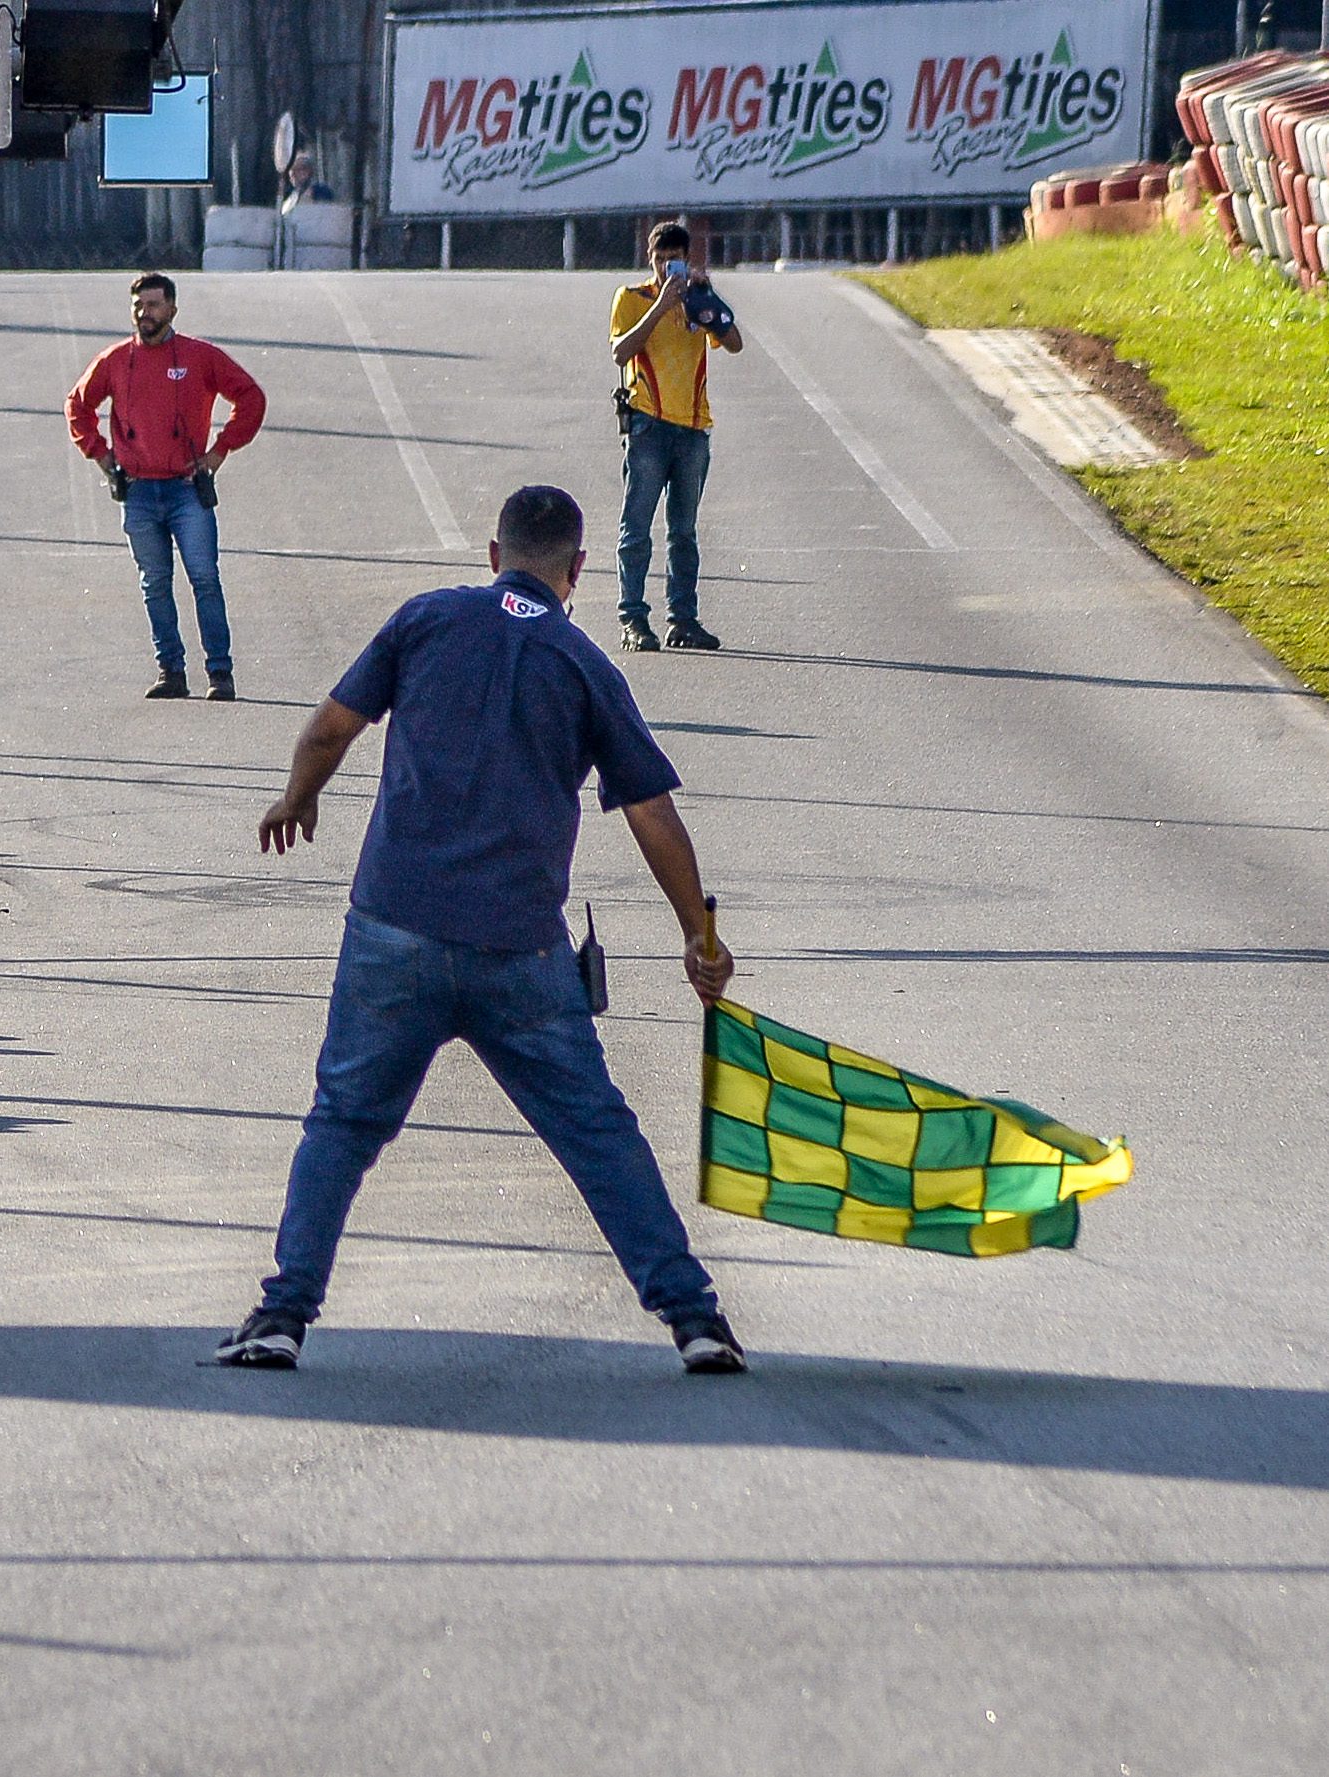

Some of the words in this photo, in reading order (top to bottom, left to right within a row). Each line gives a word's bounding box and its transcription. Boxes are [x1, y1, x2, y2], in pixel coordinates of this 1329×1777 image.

[415, 75, 645, 149] MGtires
[668, 63, 887, 141] MGtires
[907, 52, 1121, 131] MGtires
[443, 135, 547, 184] Racing
[695, 125, 795, 174] Racing
[932, 115, 1028, 167] Racing
